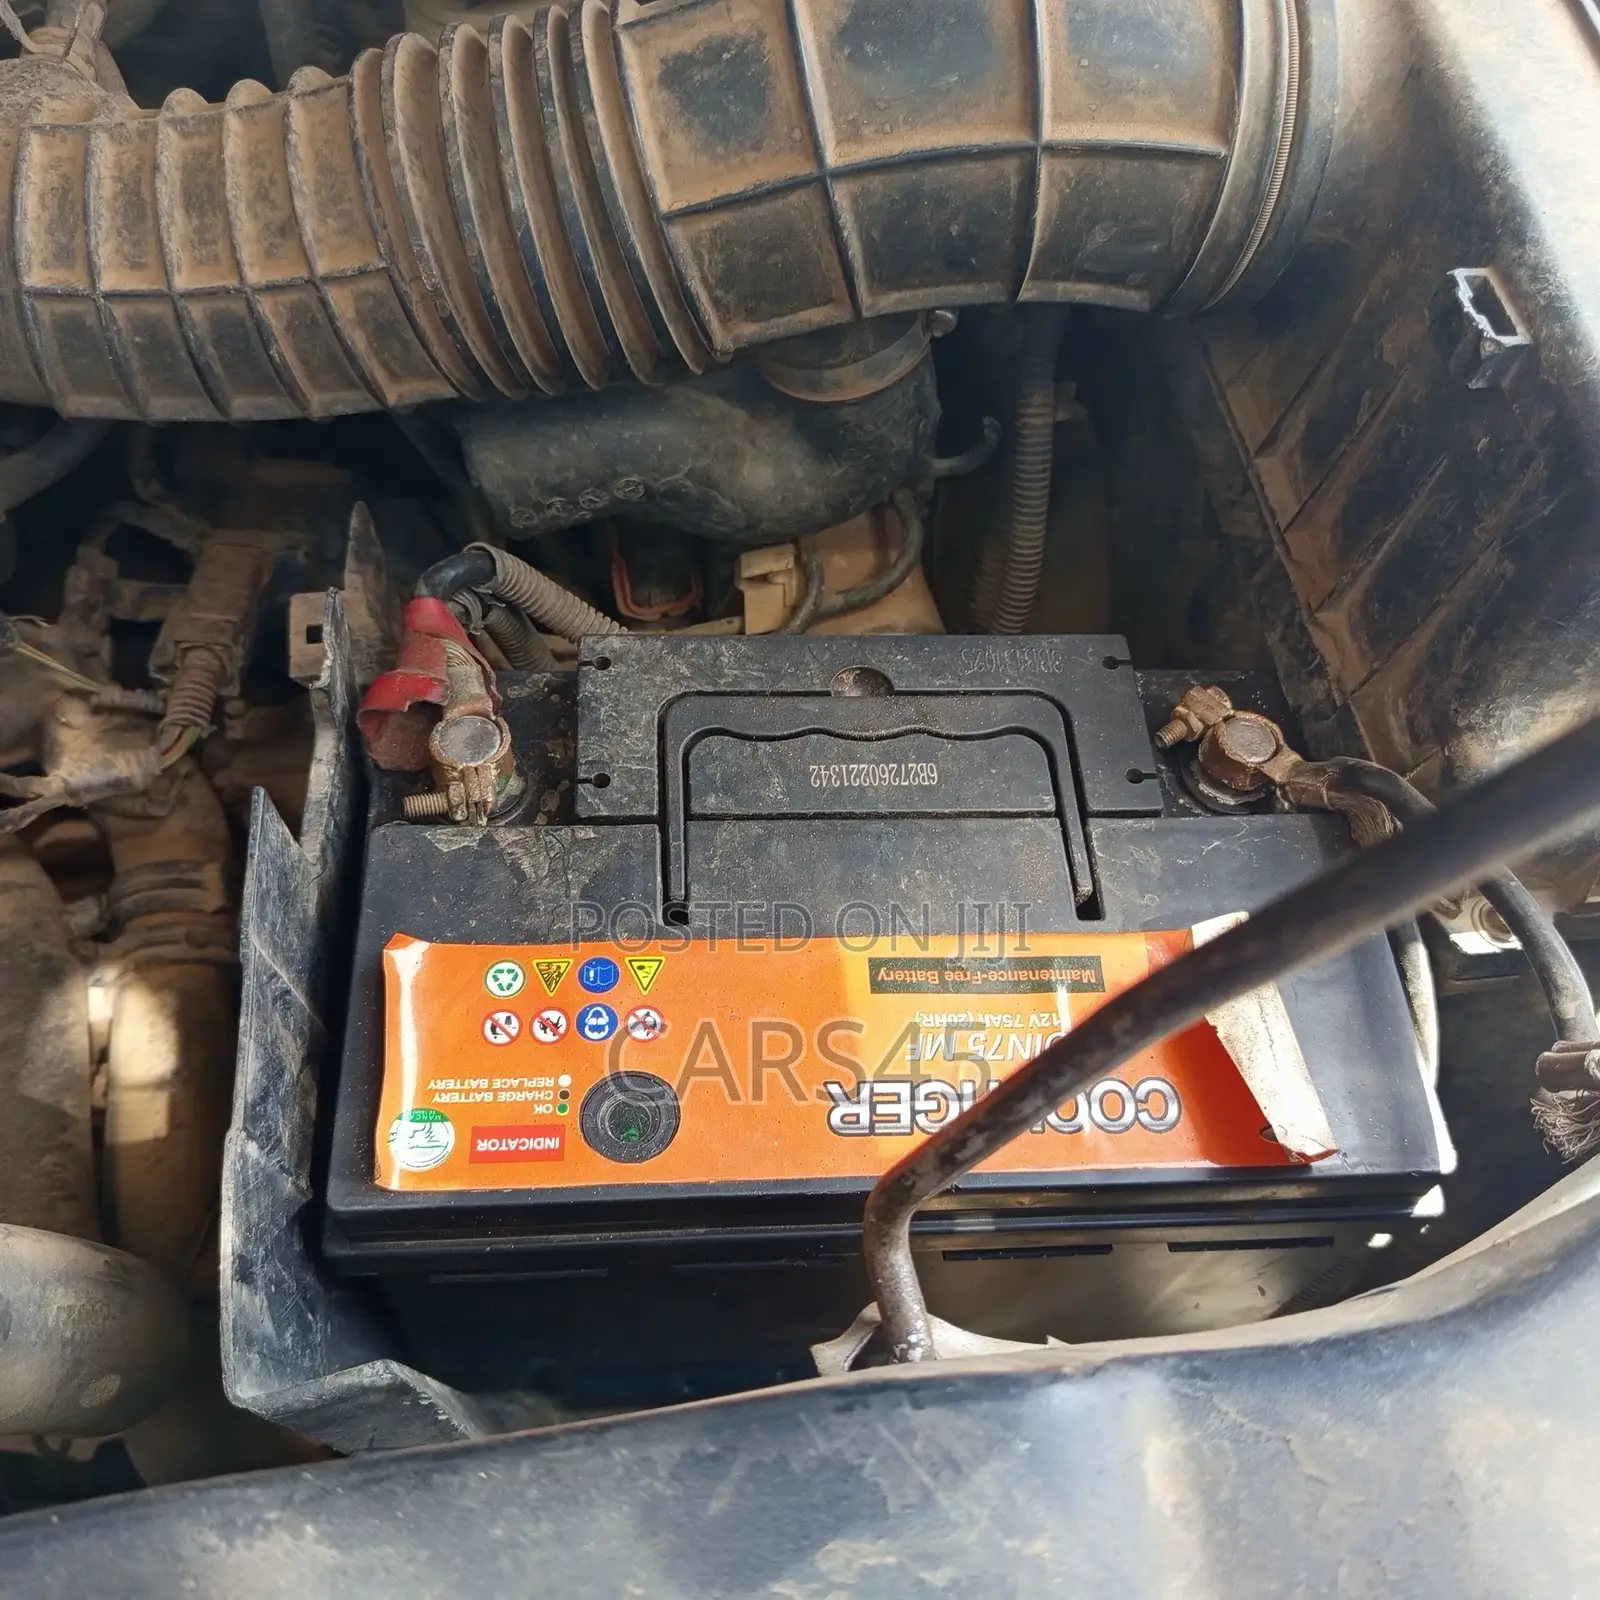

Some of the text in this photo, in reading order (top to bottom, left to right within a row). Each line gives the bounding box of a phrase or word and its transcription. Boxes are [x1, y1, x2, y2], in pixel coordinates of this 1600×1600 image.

[809, 763, 938, 787] 6B27260221342
[877, 967, 1097, 983] Maintenance-Free Battery
[979, 1012, 1024, 1028] 75Ah
[1028, 1012, 1061, 1028] 12V
[905, 1032, 957, 1062] MF
[427, 1076, 555, 1090] REPLACE BATTERY
[431, 1089, 554, 1103] CHARGE BATTERY
[532, 1103, 553, 1114] OK
[406, 1113, 442, 1121] MANCA
[476, 1137, 560, 1152] INDICATOR
